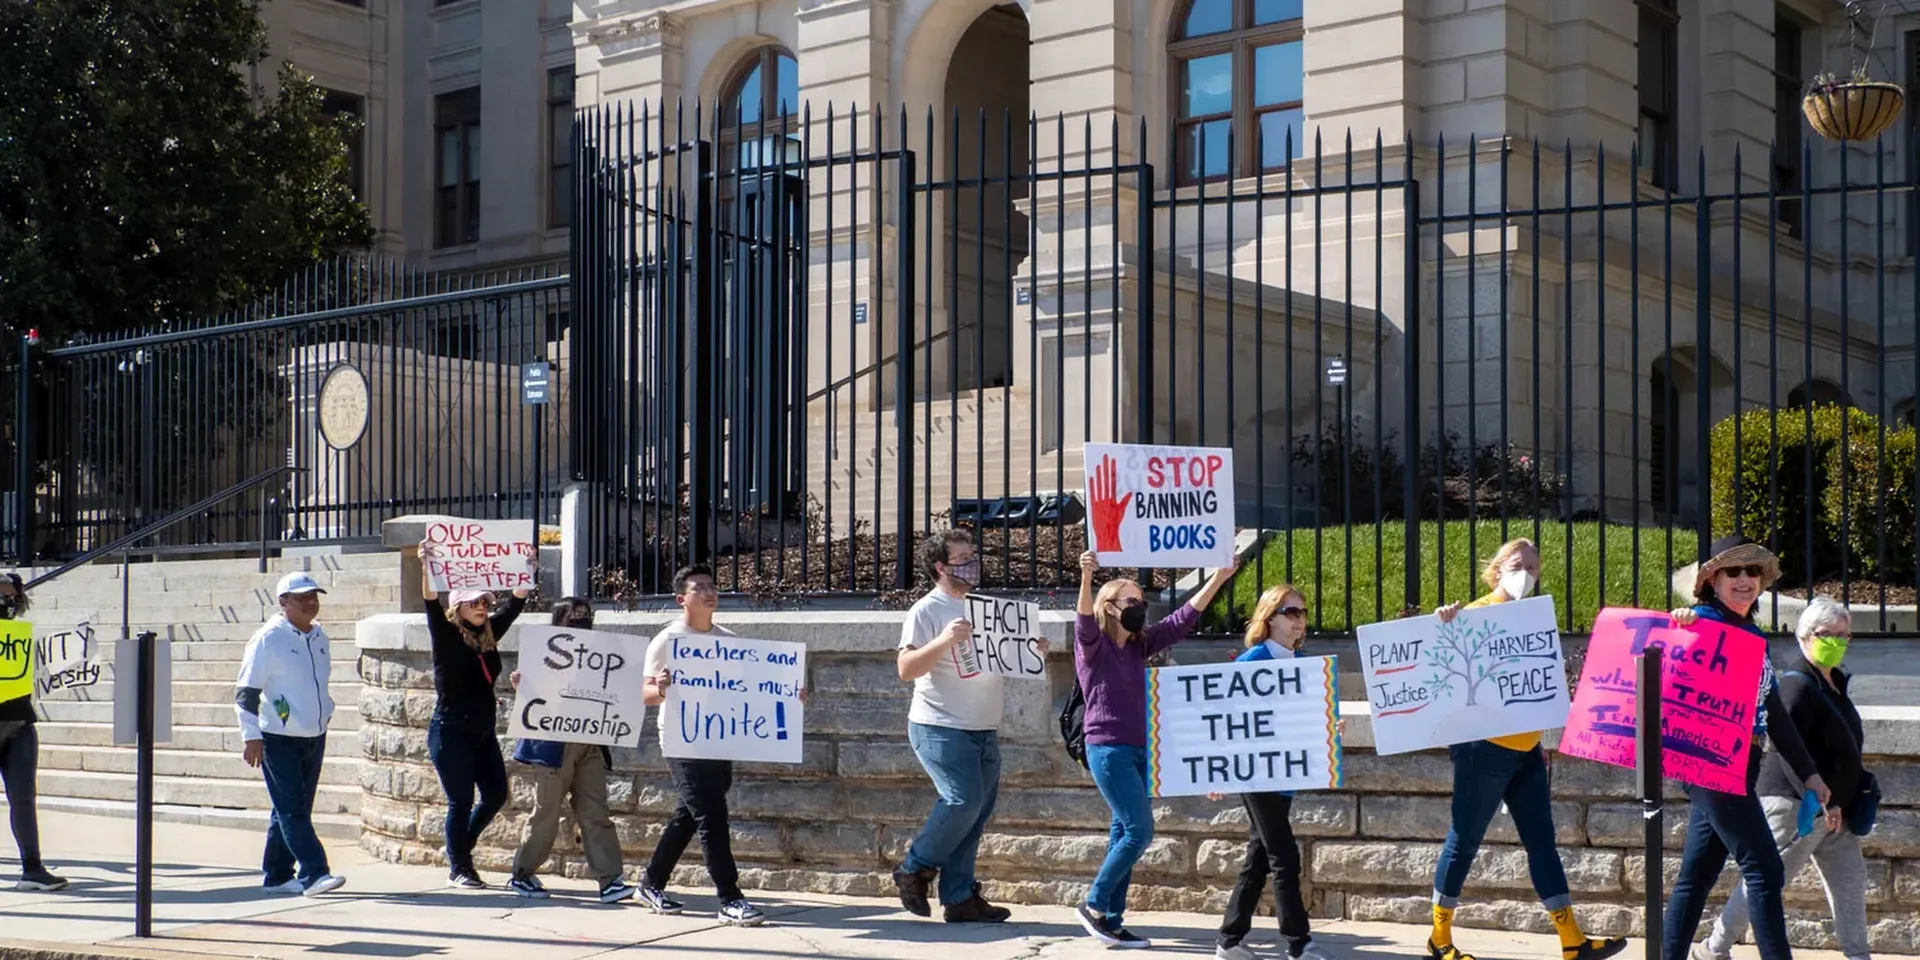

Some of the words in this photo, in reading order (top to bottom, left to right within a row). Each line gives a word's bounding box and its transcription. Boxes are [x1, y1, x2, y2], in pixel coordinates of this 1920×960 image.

[1147, 455, 1223, 489] STOP
[1135, 490, 1218, 519] BANNING
[428, 523, 484, 544] OUR
[1150, 524, 1217, 553] BOOKS
[430, 560, 501, 576] DESERVE
[442, 572, 532, 590] BETTER
[965, 594, 1030, 634] TEACH
[36, 621, 95, 670] NITY
[668, 636, 759, 662] Teachers
[767, 651, 798, 666] and
[972, 634, 1044, 675] FACTS
[1370, 640, 1423, 669] PLANT
[1488, 629, 1556, 657] HARVEST
[543, 633, 625, 690] Stop
[671, 669, 748, 692] families
[759, 680, 800, 698] must
[1177, 667, 1302, 702] TEACH
[1372, 682, 1428, 709] Justice
[1498, 665, 1557, 700] PEACE
[1672, 683, 1746, 722] TRUTH
[521, 698, 631, 744] Censorship
[681, 700, 788, 744] Unite!
[1201, 710, 1275, 741] THE
[1182, 750, 1309, 783] TRUTH
